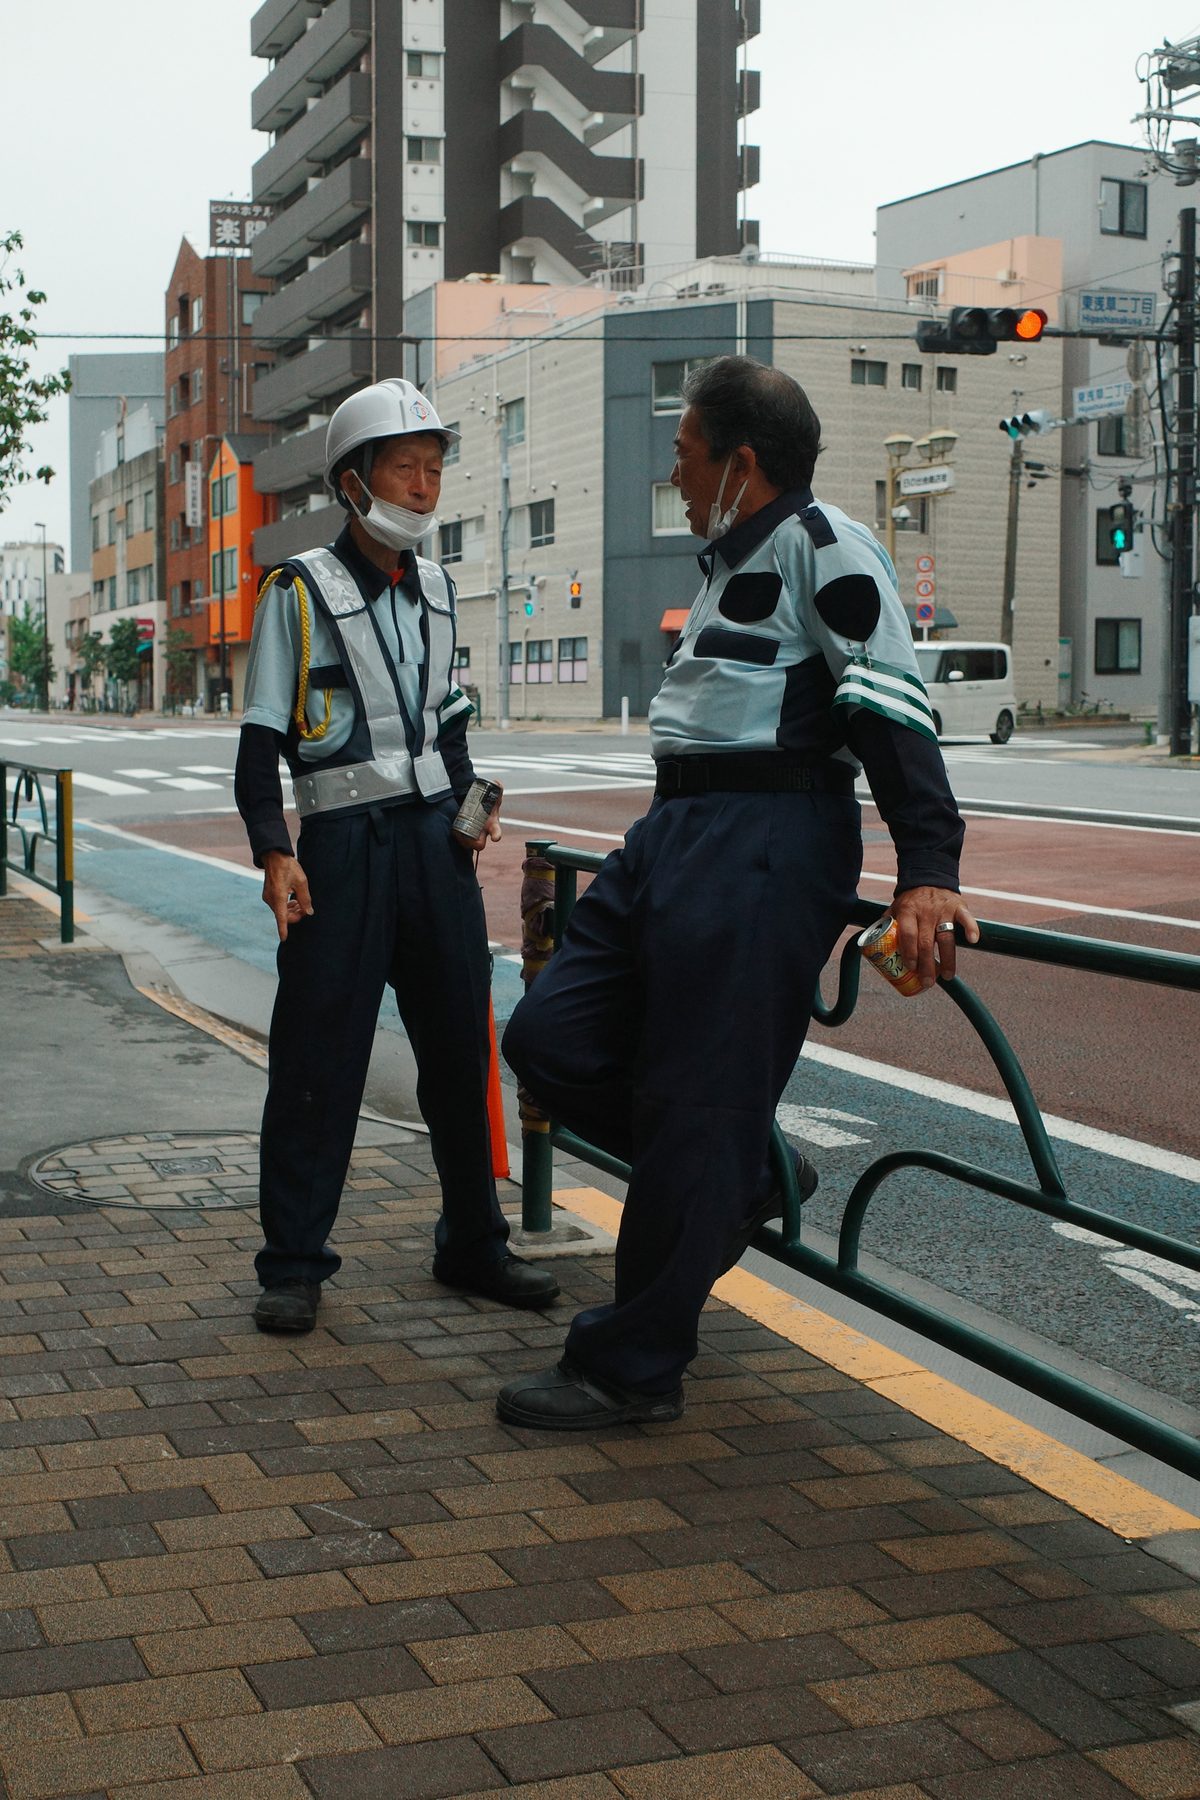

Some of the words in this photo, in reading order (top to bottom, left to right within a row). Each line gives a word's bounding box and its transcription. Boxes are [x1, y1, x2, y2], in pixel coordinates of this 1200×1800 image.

[210, 205, 273, 217] ビジネスホテル
[1082, 295, 1153, 314] 東浅草二丁目
[1079, 383, 1132, 401] 東浅草二丁目
